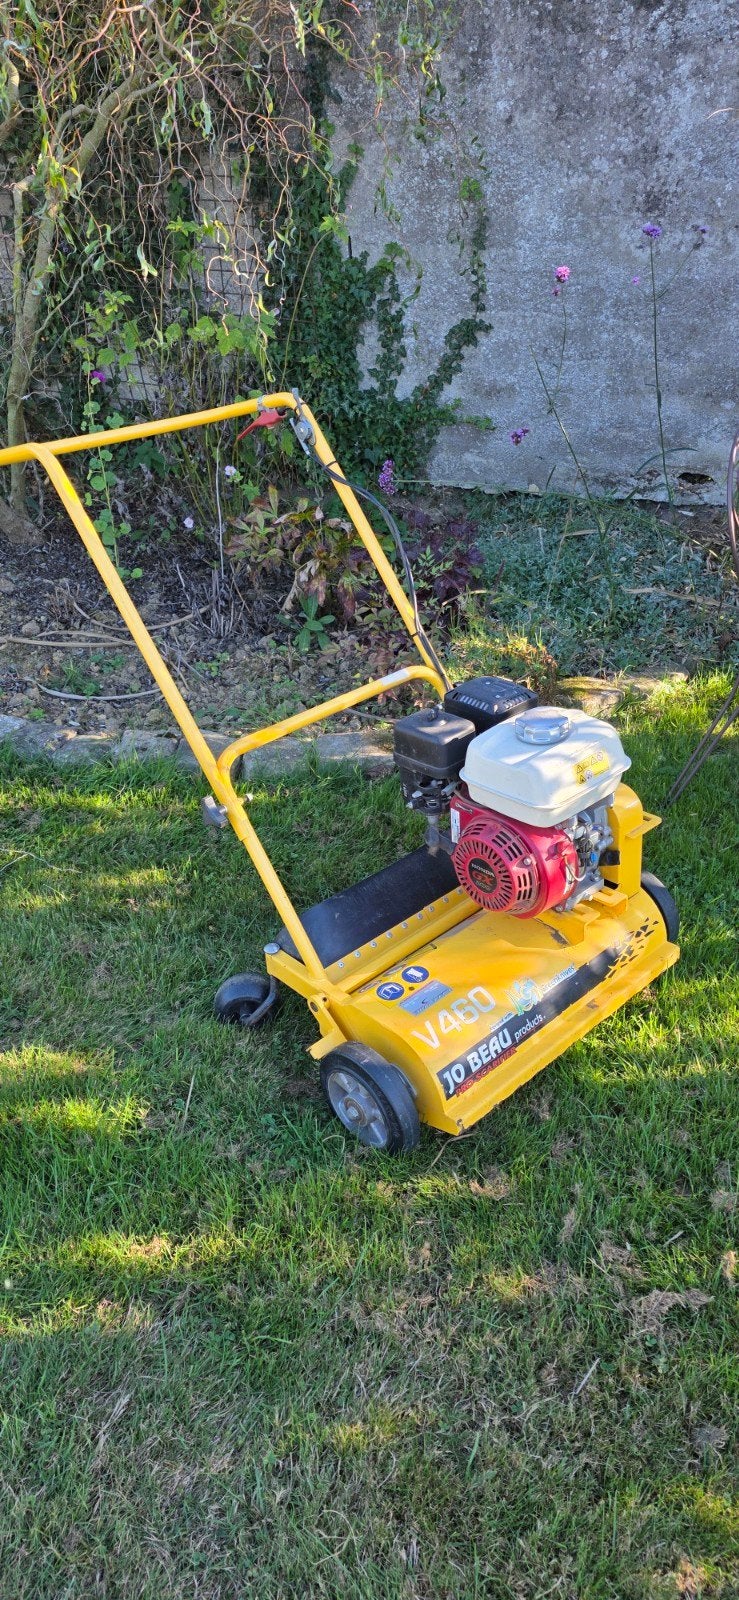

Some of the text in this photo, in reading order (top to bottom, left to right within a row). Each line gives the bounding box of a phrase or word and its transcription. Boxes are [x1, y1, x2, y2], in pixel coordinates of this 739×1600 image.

[471, 862, 496, 878] HONDA
[472, 870, 495, 887] GX
[411, 986, 496, 1049] V460
[443, 1063, 466, 1094] JO
[466, 1028, 512, 1073] BEAU
[455, 1079, 475, 1098] PRO
